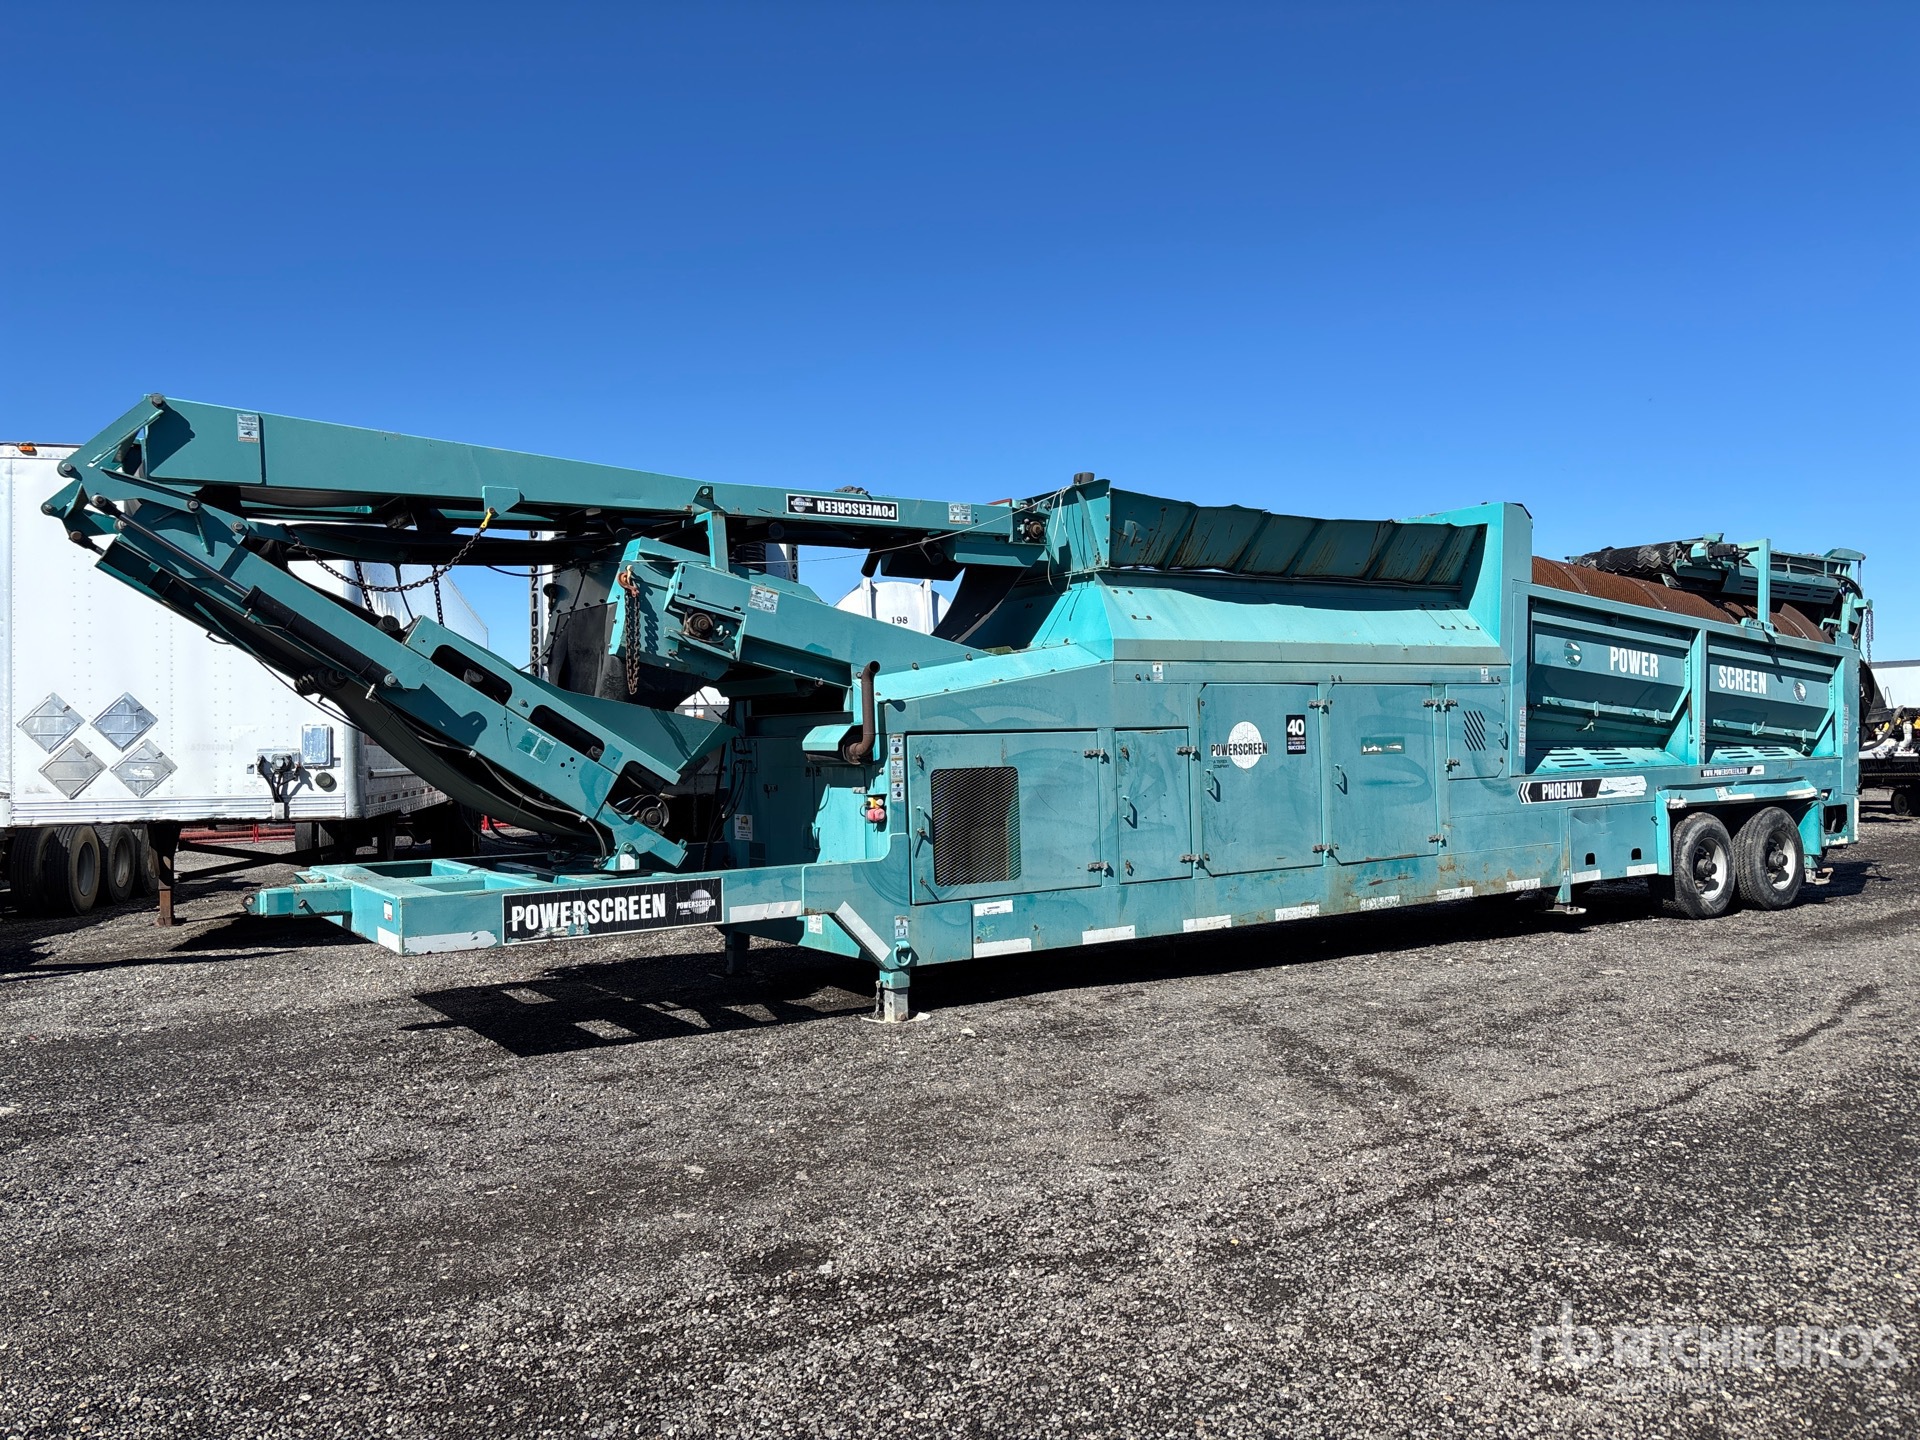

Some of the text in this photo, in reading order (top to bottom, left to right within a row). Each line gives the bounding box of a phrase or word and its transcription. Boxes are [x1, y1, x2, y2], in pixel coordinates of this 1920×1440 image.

[817, 499, 895, 518] POWERSCREEN
[891, 616, 908, 625] 198
[1610, 646, 1659, 678] POWER
[1718, 665, 1767, 695] SCREEN
[1287, 719, 1305, 736] 40
[1211, 742, 1268, 756] POWERSCREEN
[1541, 781, 1583, 800] PHOENIX
[511, 892, 666, 932] POWERSCREEN
[676, 899, 716, 909] POWERSCREEN
